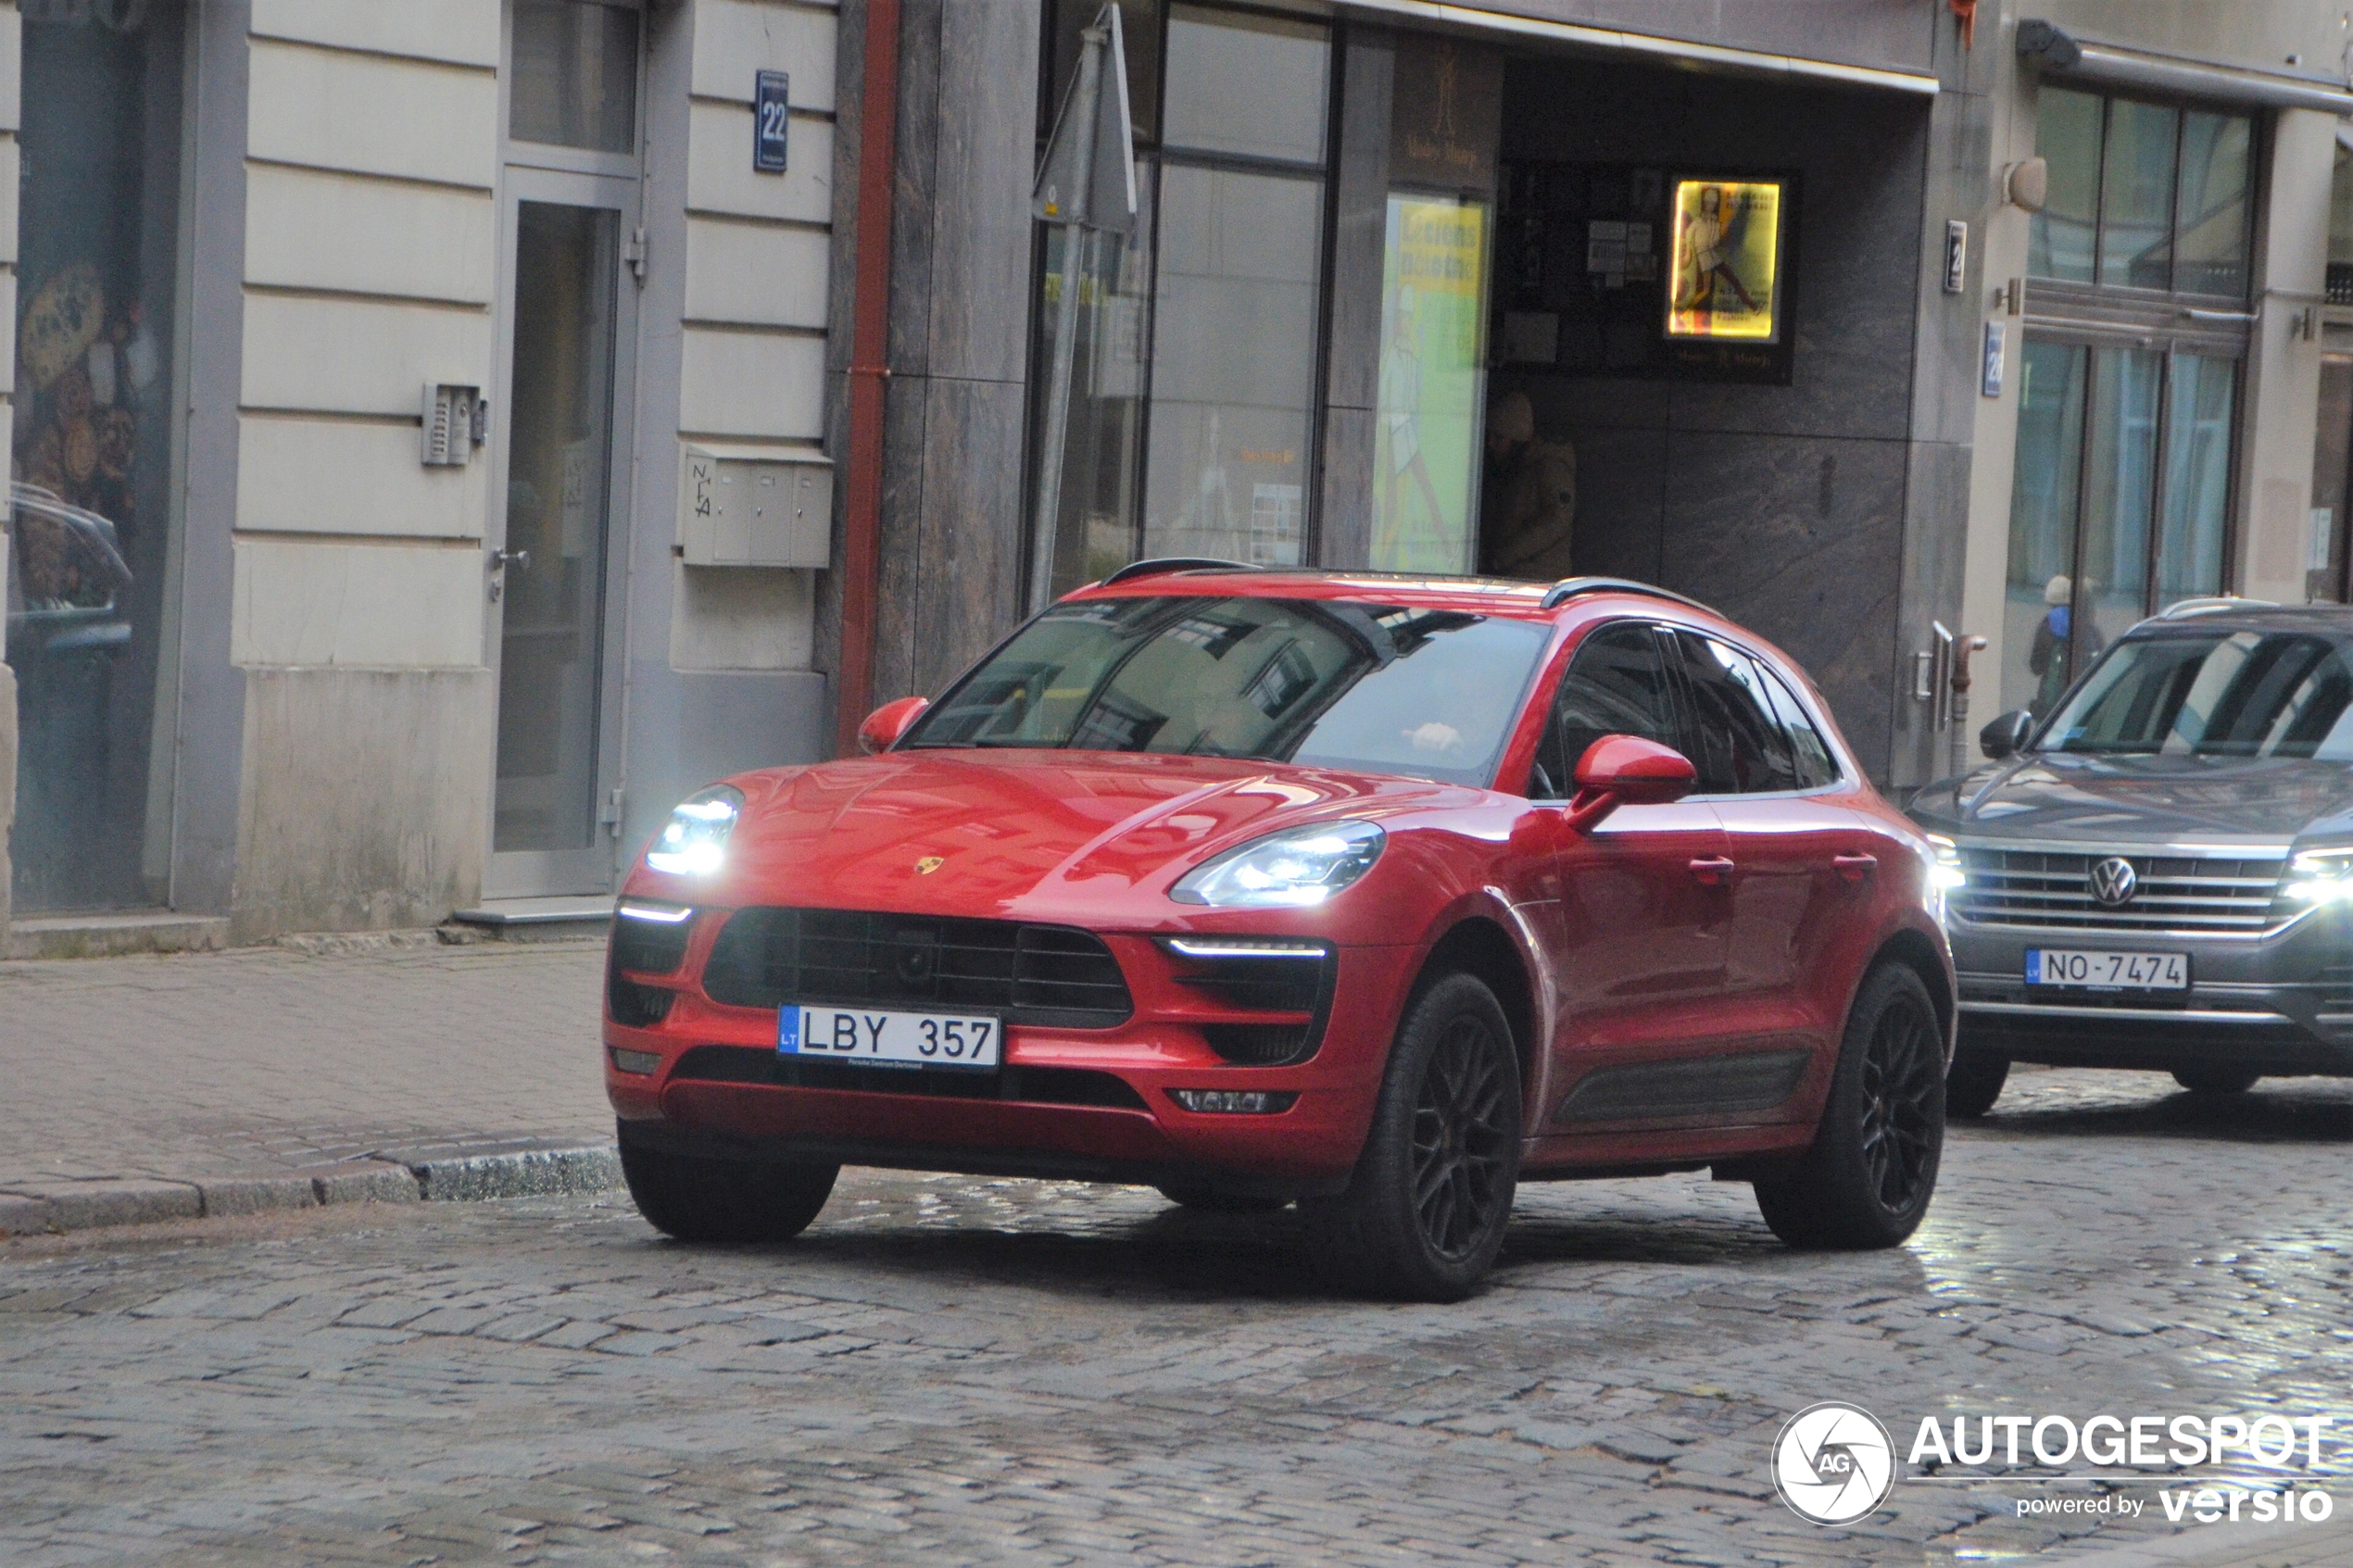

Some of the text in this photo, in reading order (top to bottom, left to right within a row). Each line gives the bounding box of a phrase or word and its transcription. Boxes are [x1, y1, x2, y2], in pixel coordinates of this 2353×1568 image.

[762, 101, 786, 141] 22
[781, 1034, 798, 1045] LT
[804, 1011, 992, 1059] LBY 357
